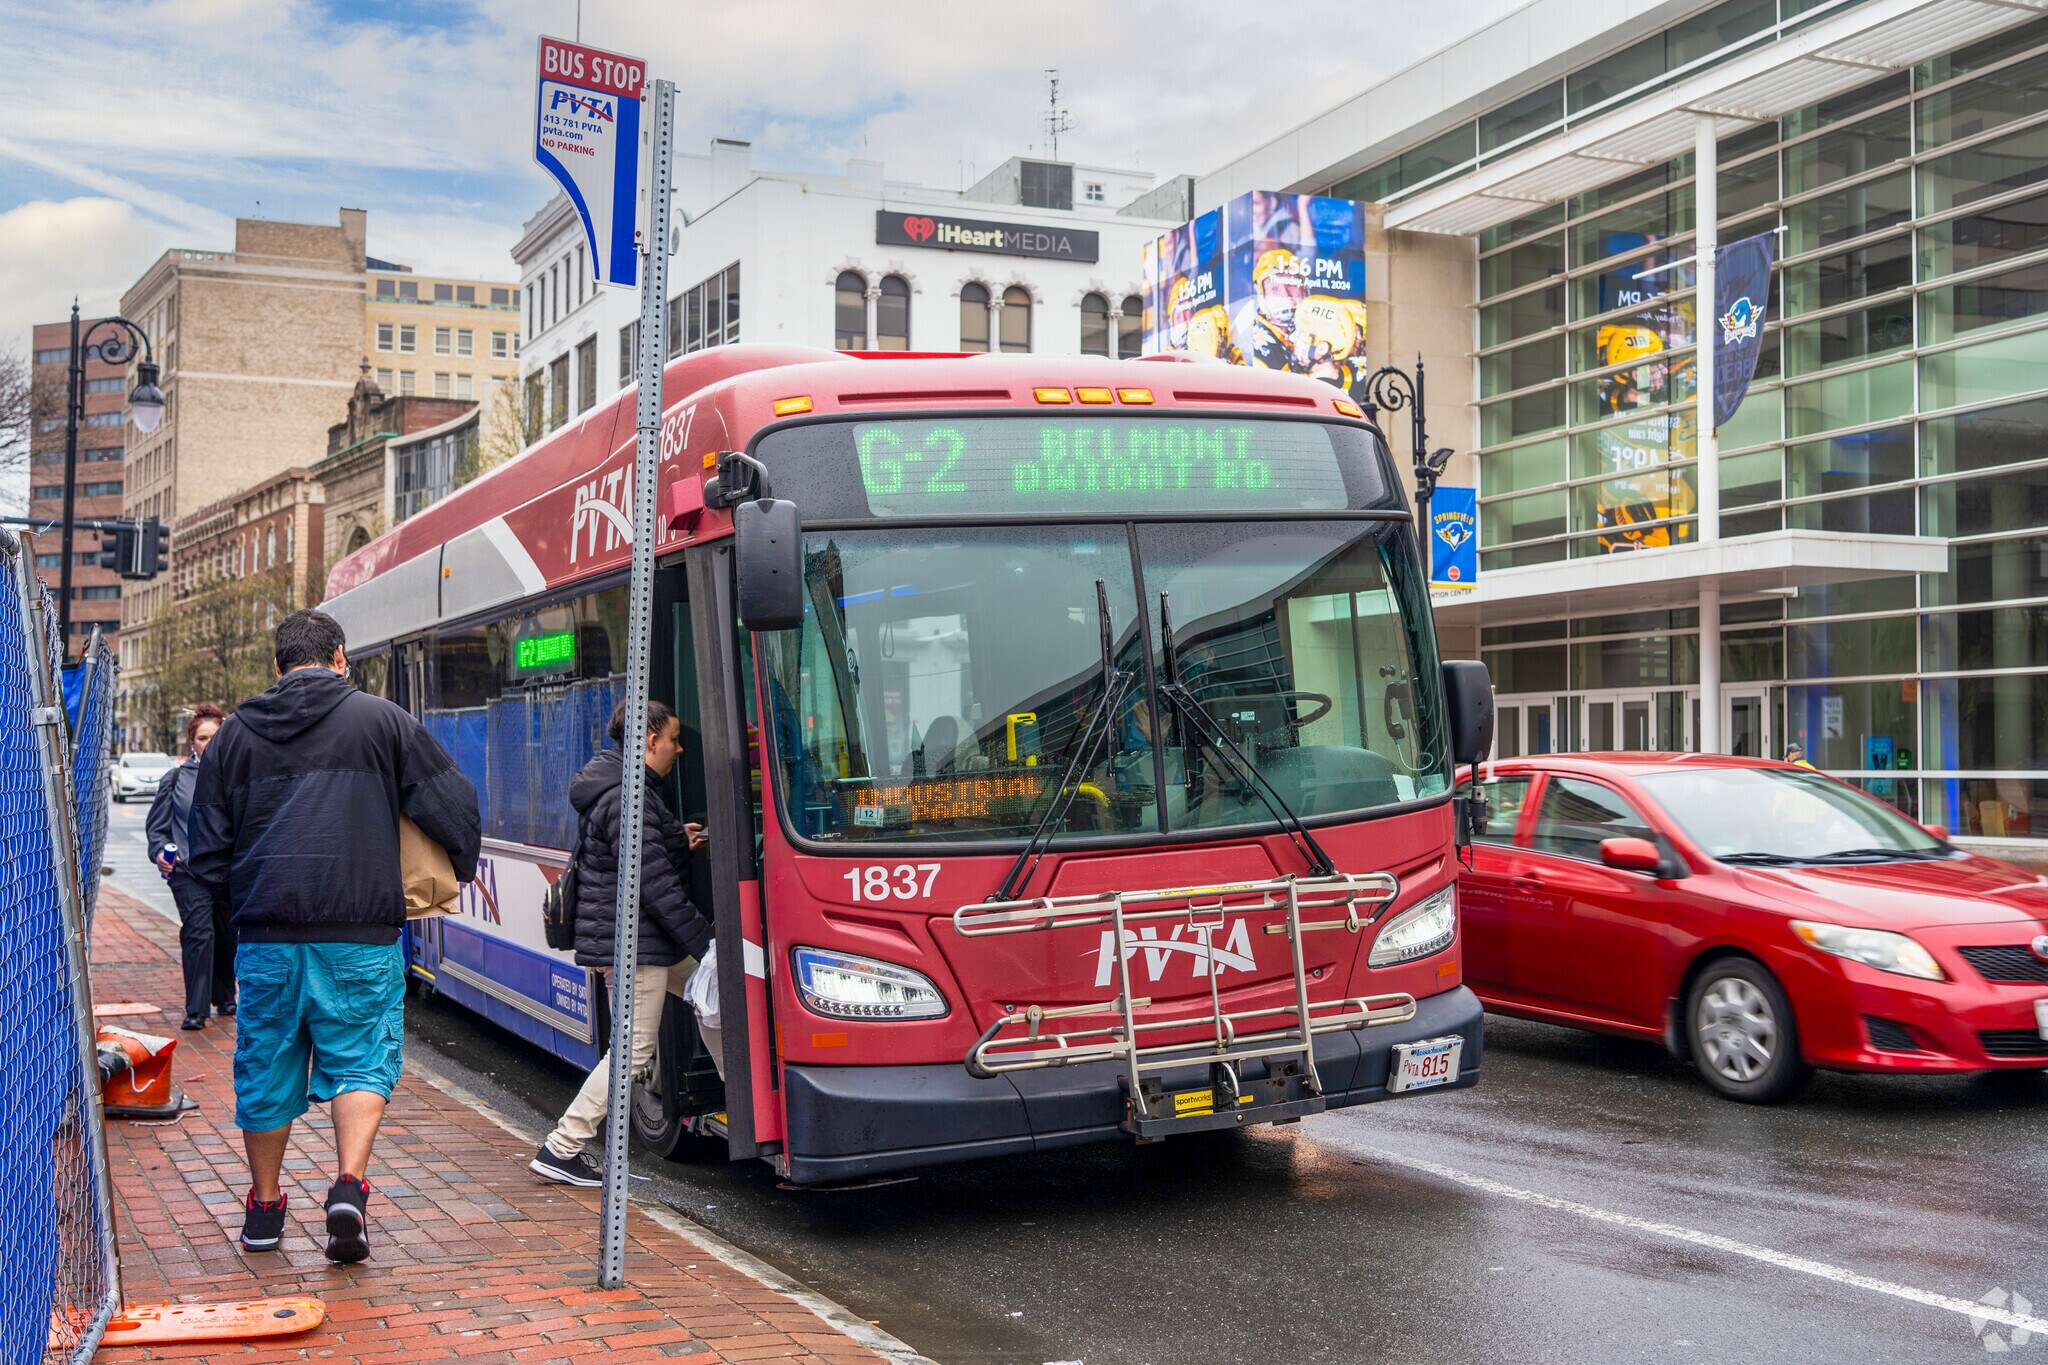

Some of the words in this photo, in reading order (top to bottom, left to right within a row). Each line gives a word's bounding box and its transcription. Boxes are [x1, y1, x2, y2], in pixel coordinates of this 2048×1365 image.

[544, 45, 585, 79] BUS
[591, 57, 641, 91] STOP
[550, 90, 614, 122] PVTA
[543, 114, 560, 125] 413
[563, 118, 579, 128] 781
[581, 122, 603, 134] PVTA
[543, 126, 583, 140] pvta.com
[542, 138, 555, 147] NO
[557, 141, 595, 156] PARKING
[1277, 255, 1312, 277] 1:56
[1315, 258, 1343, 280] PM
[1197, 271, 1213, 295] PM
[1331, 280, 1351, 291] 2024
[658, 403, 697, 465] 1837
[861, 427, 967, 493] G-2
[1041, 427, 1252, 460] BELMONT
[1012, 461, 1195, 493] DWIGHT
[569, 462, 634, 565] PVTA
[1433, 511, 1475, 526] SPRINGFIELD
[1430, 591, 1449, 599] NTION
[1449, 588, 1472, 597] CENTER
[856, 776, 1042, 806] INDUSTRIAL
[864, 810, 874, 818] 12
[911, 800, 990, 822] PARK
[843, 863, 942, 902] 1837
[1095, 918, 1258, 988] PVTA
[552, 973, 571, 994] OPERATED
[571, 981, 578, 996] BY
[556, 991, 571, 1010] OWNED
[571, 998, 577, 1013] BY
[1421, 1053, 1450, 1078] 815
[1175, 1094, 1212, 1106] sportworks
